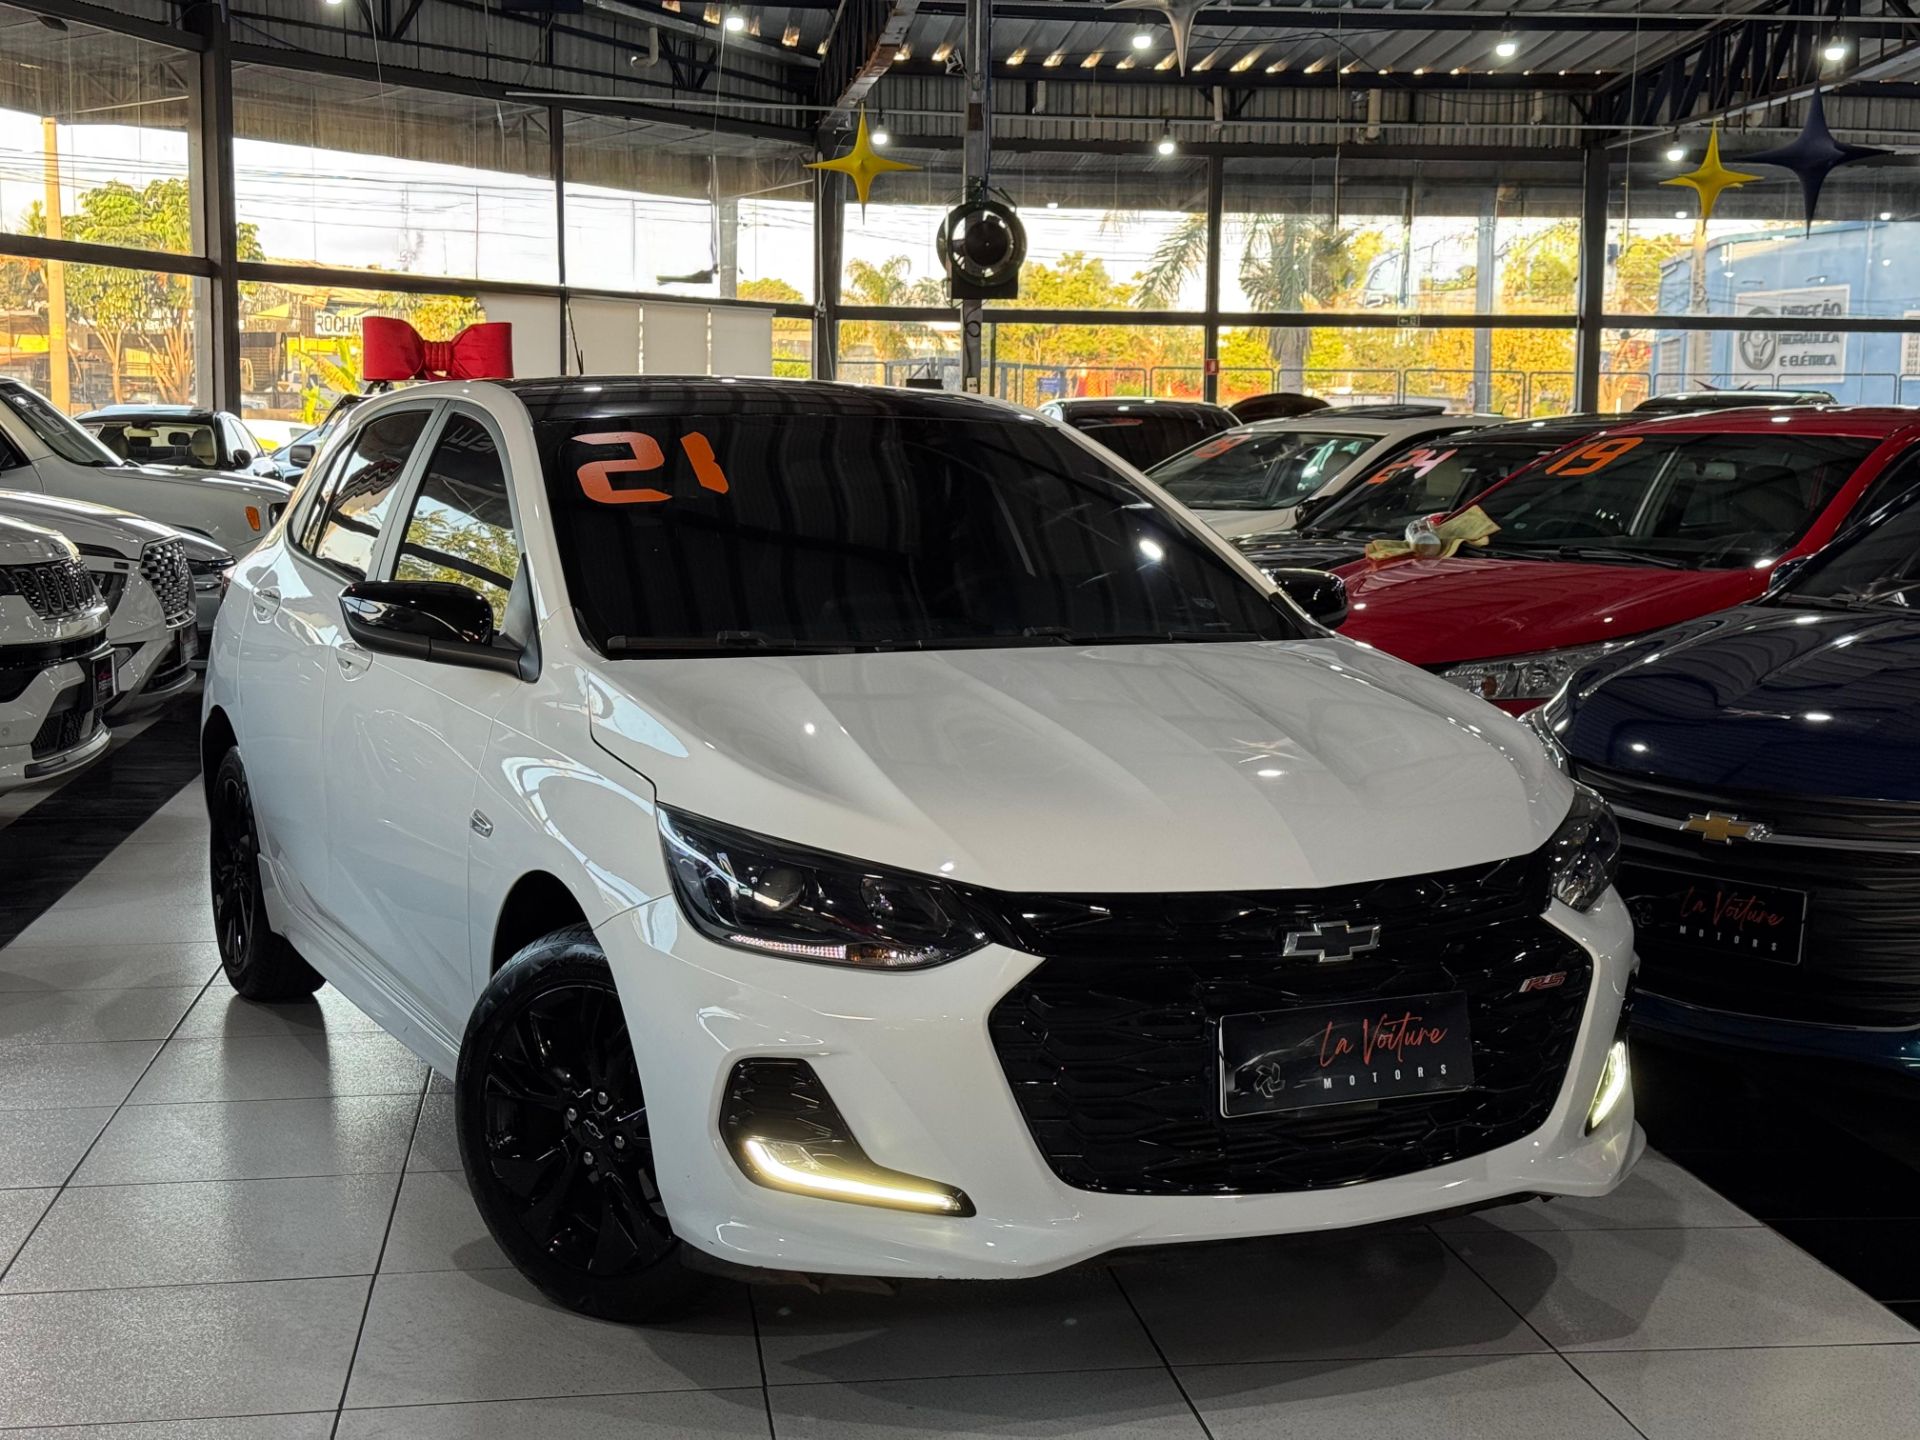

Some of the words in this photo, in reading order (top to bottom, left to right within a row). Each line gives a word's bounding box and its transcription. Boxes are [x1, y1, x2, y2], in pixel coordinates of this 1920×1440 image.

[316, 314, 361, 333] ROCHA
[570, 431, 730, 504] 21
[1544, 437, 1645, 476] 19
[1679, 886, 1707, 918] La
[1713, 890, 1785, 931] Voiture
[1679, 925, 1778, 951] MOTORS
[1319, 1020, 1355, 1068] La
[1361, 1010, 1449, 1066] Voiture
[1322, 1063, 1447, 1090] MOTORS
